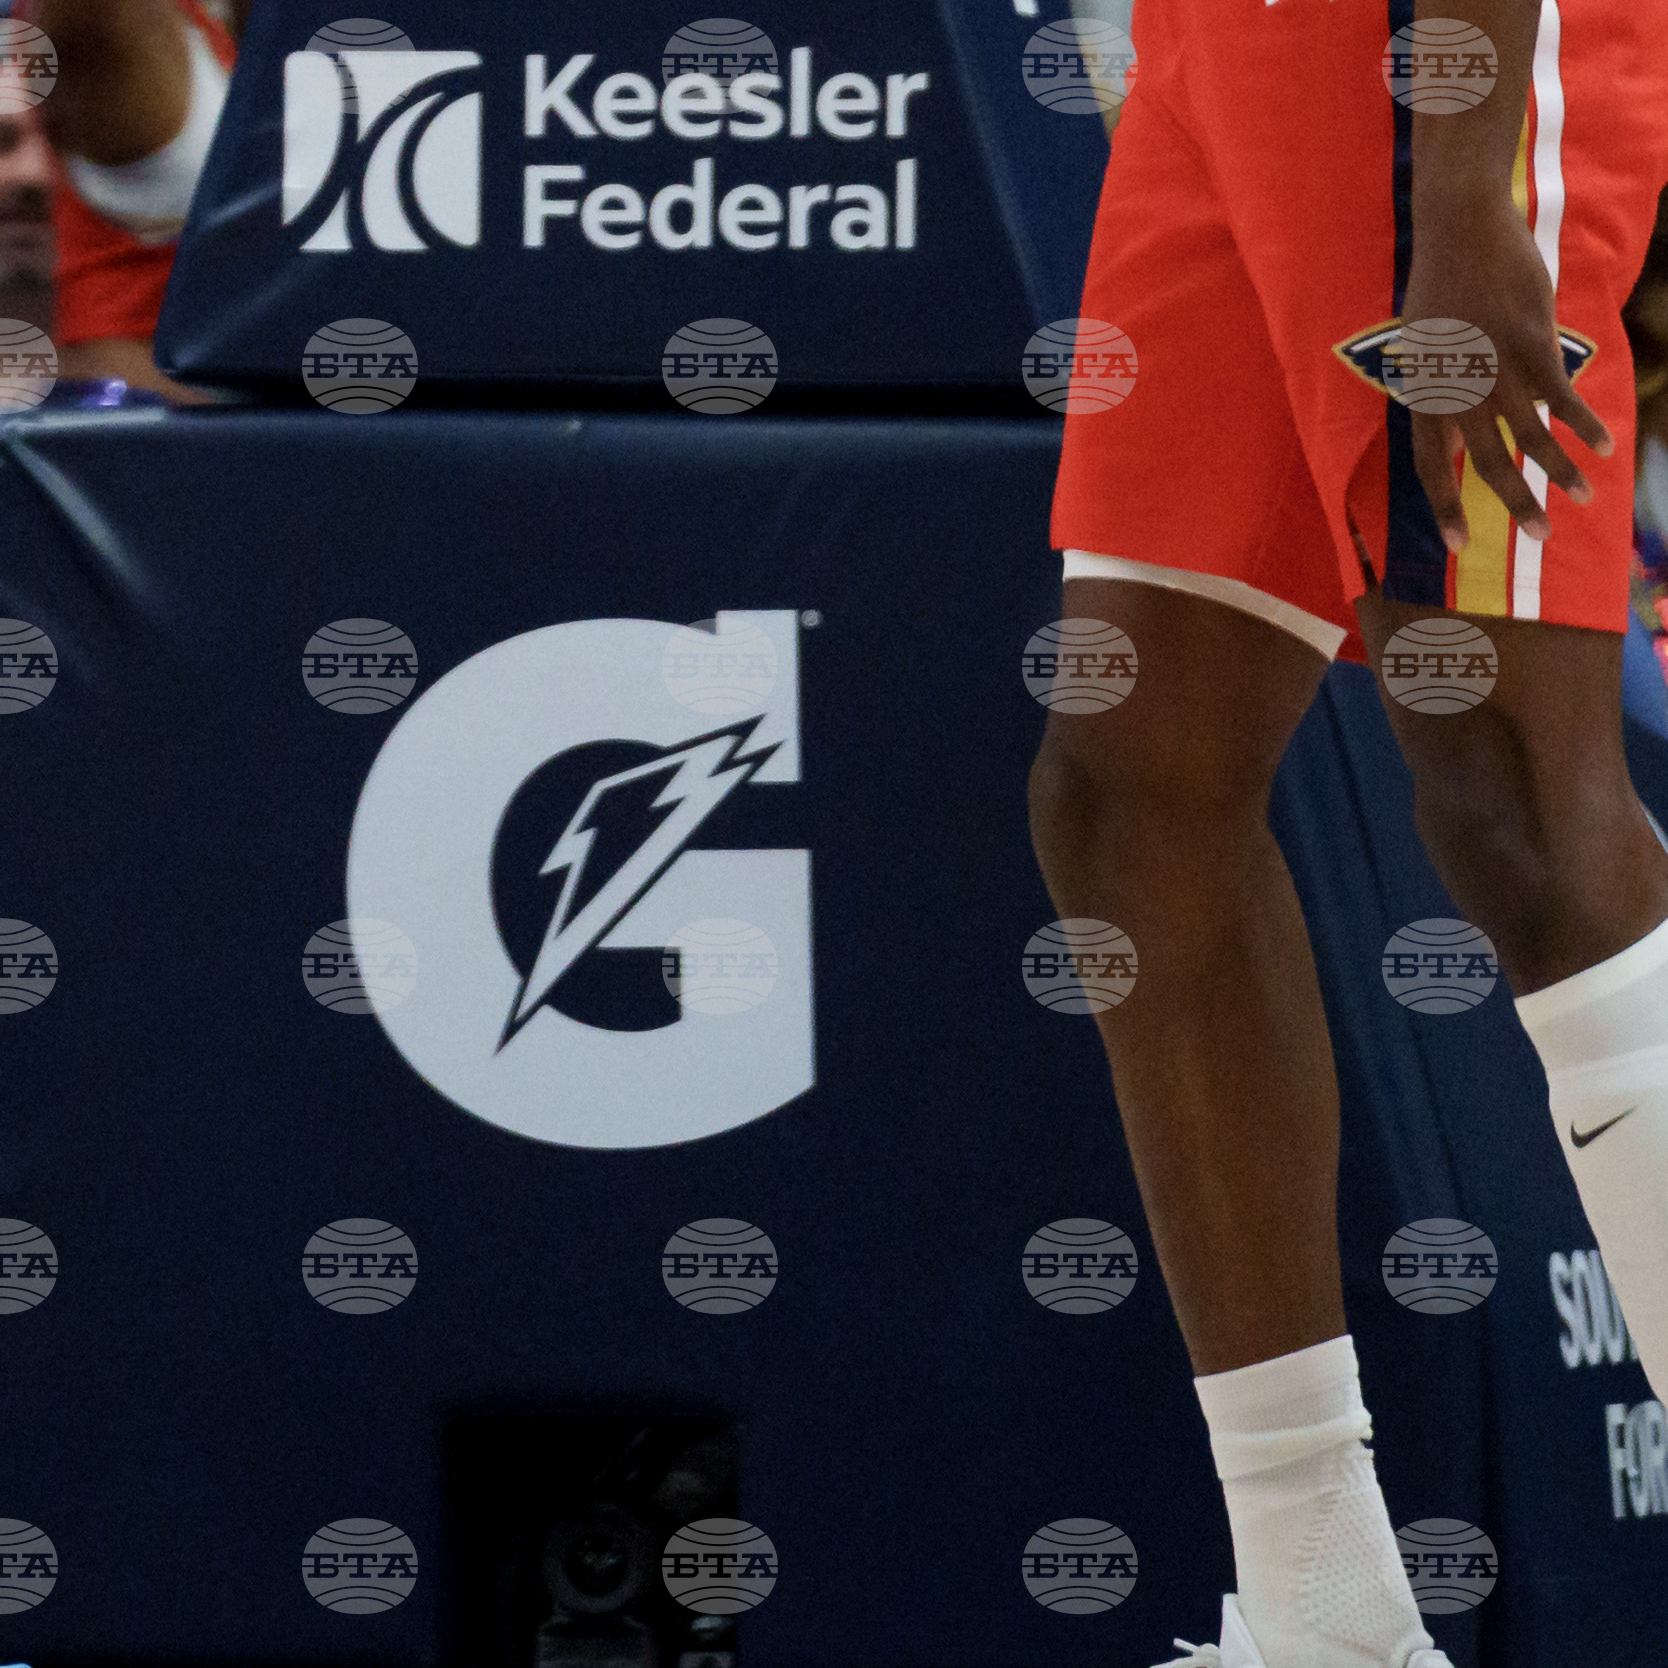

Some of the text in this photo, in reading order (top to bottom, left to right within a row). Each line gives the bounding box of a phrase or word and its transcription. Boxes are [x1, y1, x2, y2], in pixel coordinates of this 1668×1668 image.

[524, 46, 930, 139] Keesler
[522, 157, 918, 251] Federal
[1548, 1248, 1638, 1369] SOU
